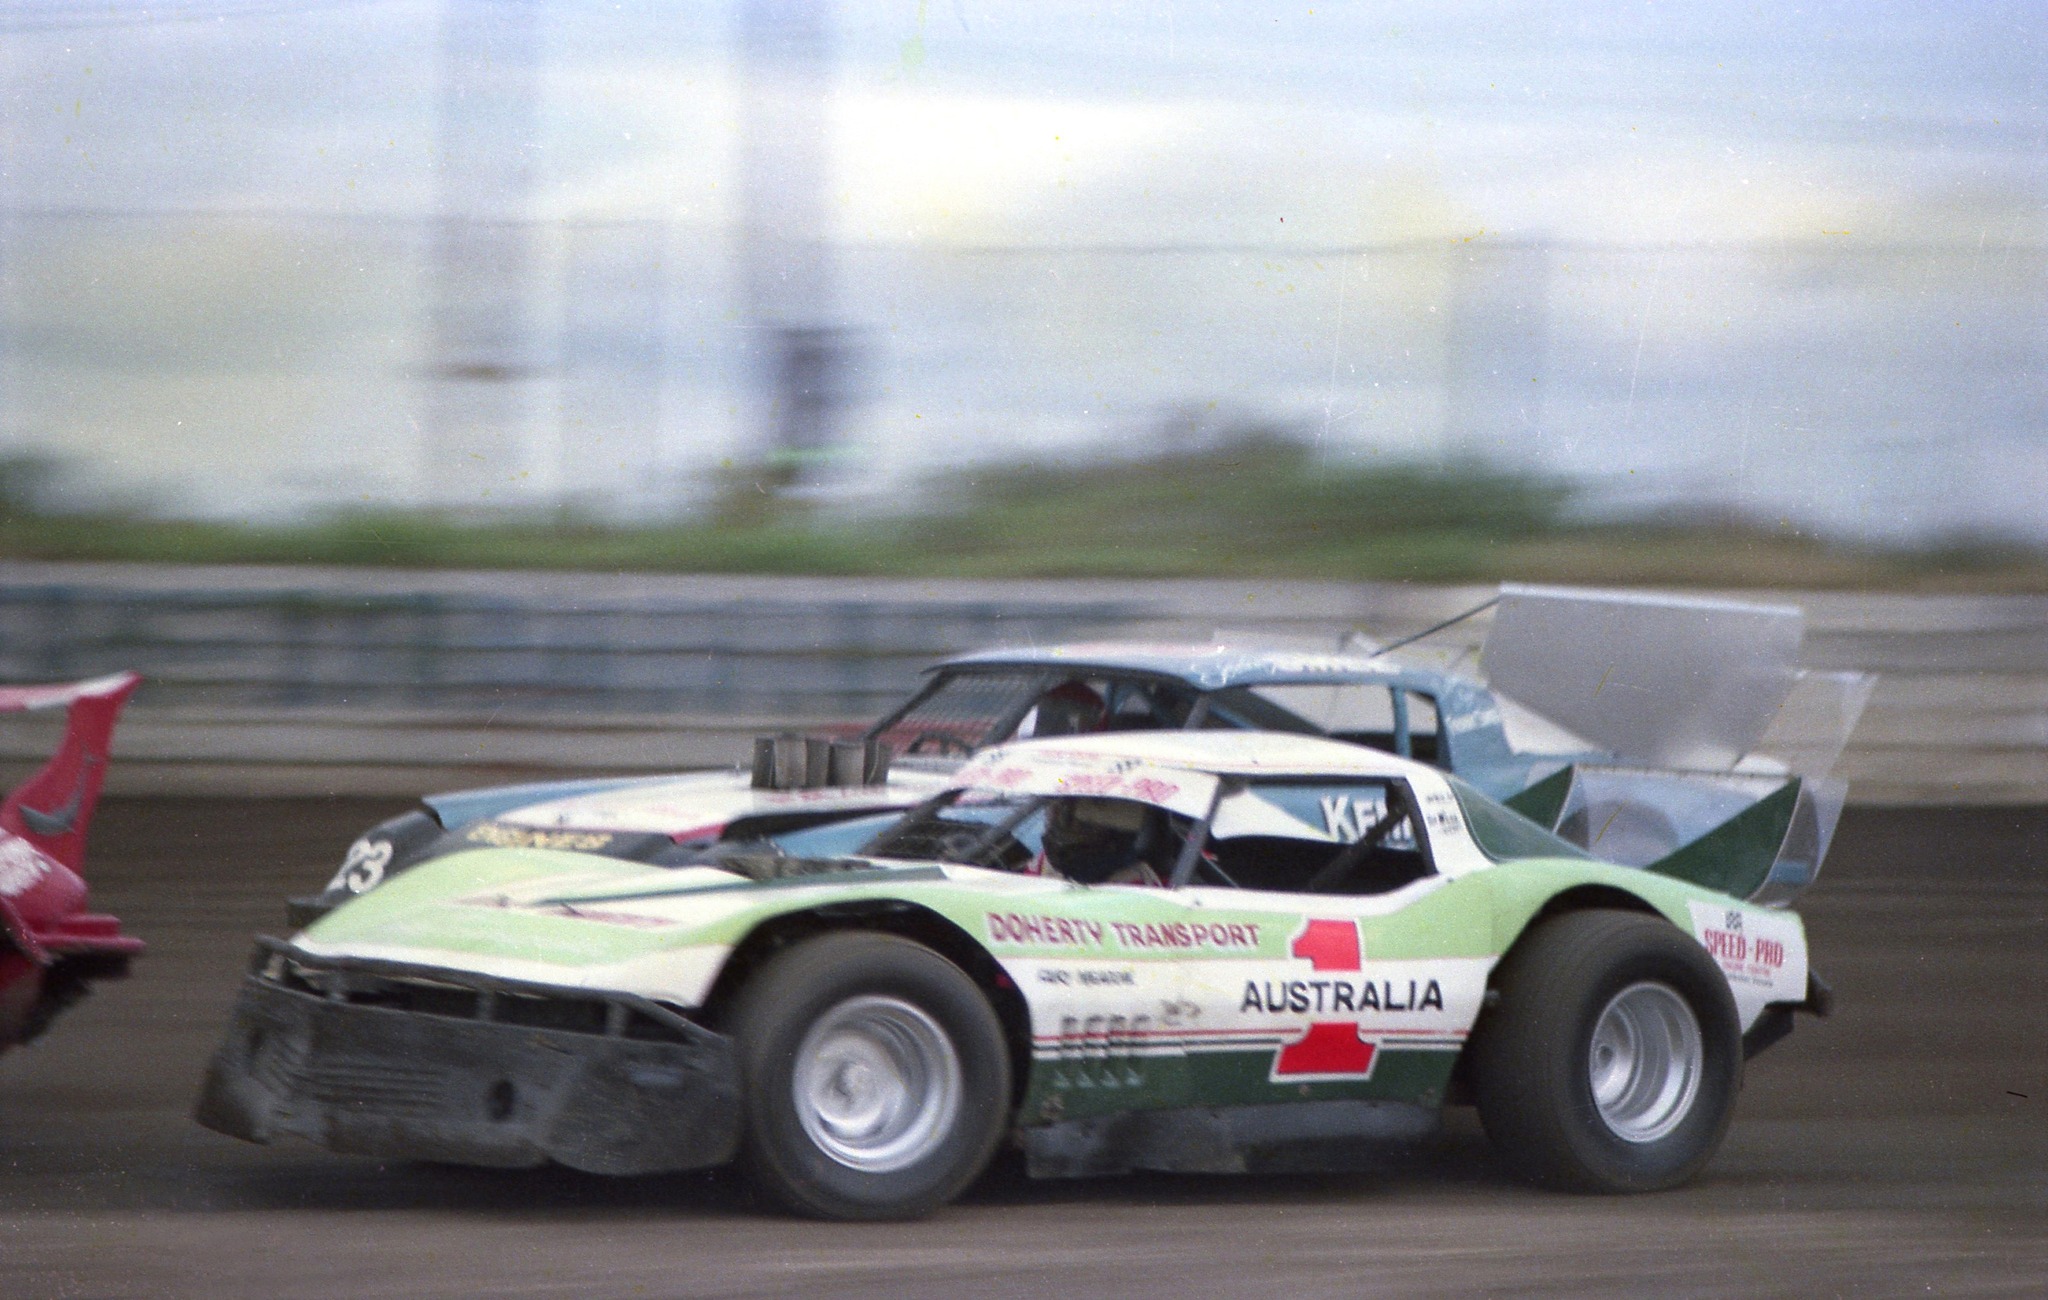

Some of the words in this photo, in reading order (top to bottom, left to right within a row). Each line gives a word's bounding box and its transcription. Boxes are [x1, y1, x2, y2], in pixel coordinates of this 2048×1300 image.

[988, 912, 1103, 946] DOHERTY
[1110, 921, 1260, 947] TRANSPORT
[1240, 979, 1443, 1013] AUSTRALIA
